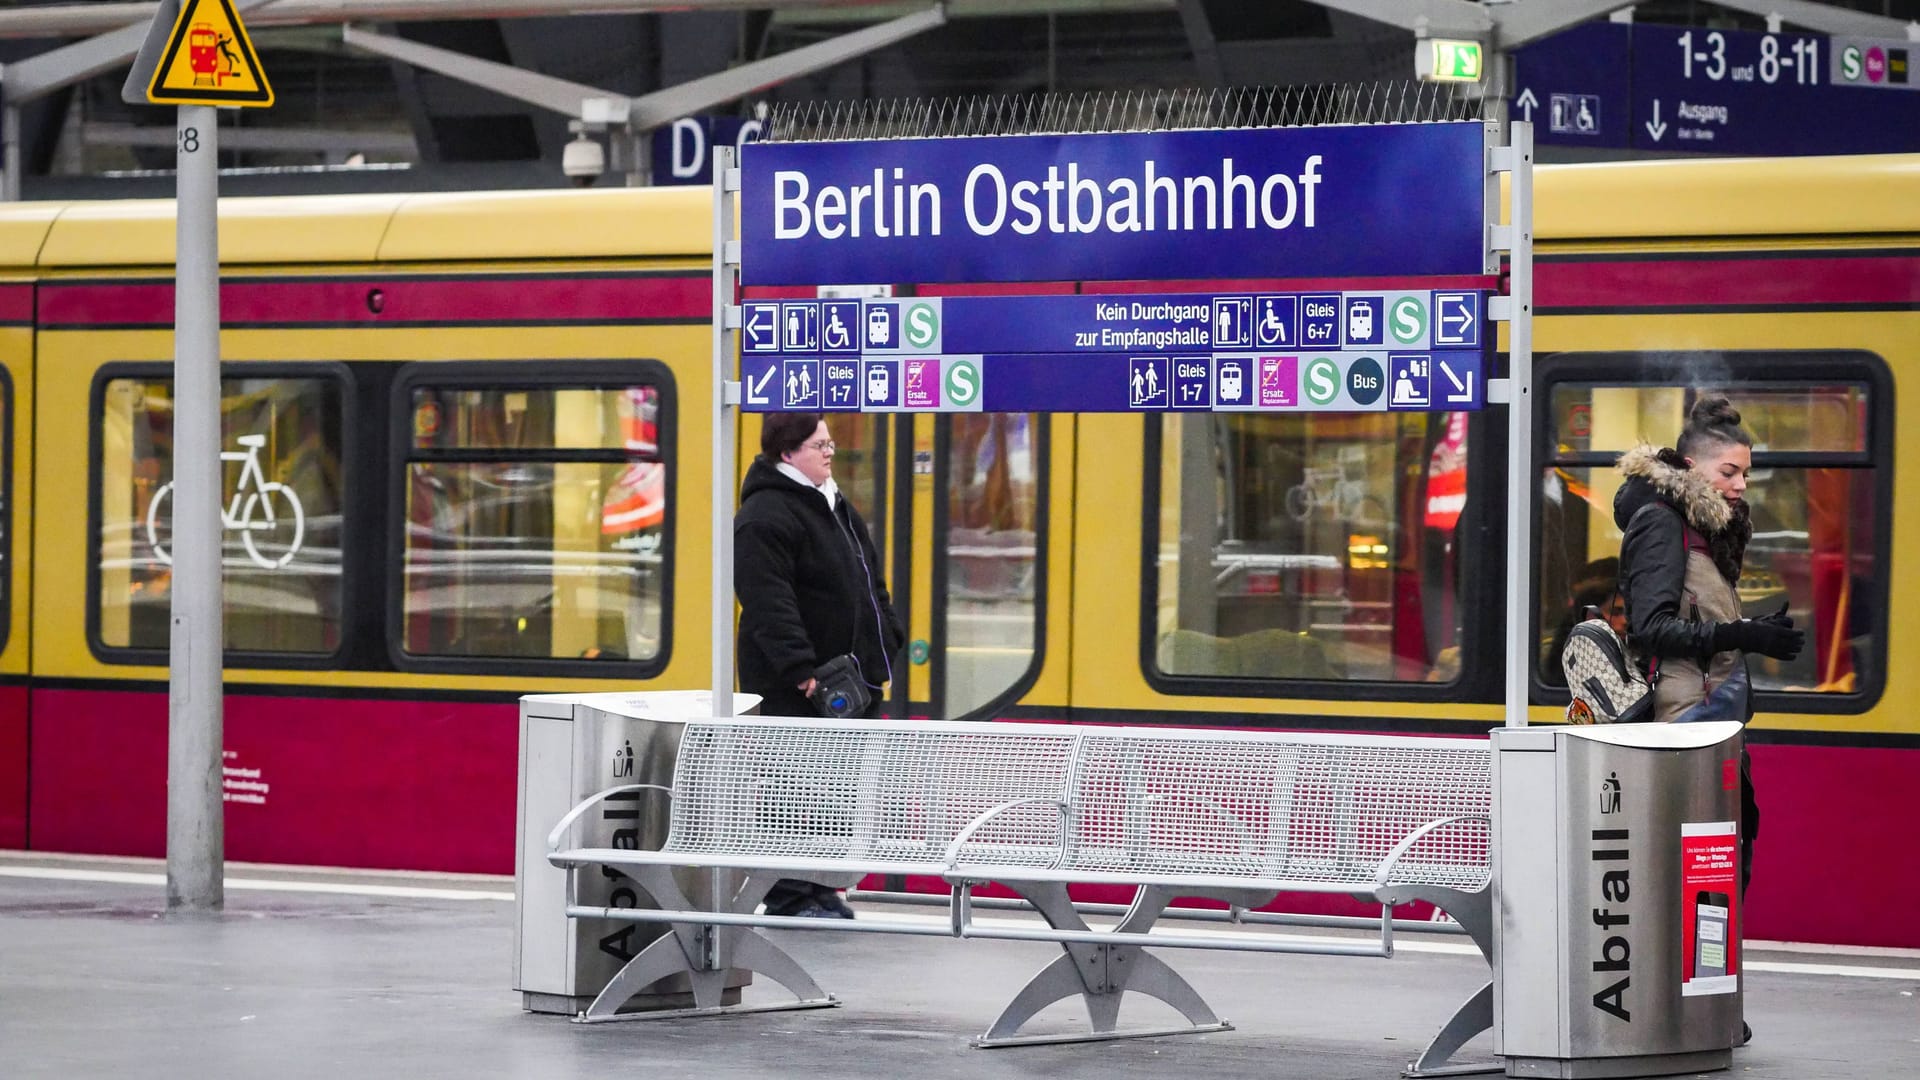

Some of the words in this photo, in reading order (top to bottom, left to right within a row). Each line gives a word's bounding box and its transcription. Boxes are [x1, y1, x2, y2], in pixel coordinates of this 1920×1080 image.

[1678, 31, 1726, 80] 1-3
[1731, 64, 1754, 81] und
[1759, 35, 1818, 85] 8-11
[1843, 47, 1860, 79] S
[1678, 100, 1728, 124] Ausgang
[672, 118, 705, 178] D
[774, 168, 942, 240] Berlin
[963, 155, 1322, 236] Ostbahnhof
[1096, 303, 1127, 321] Kein
[1131, 302, 1210, 324] Durchgang
[1305, 303, 1335, 317] Gleis
[1395, 301, 1420, 339] S
[910, 307, 933, 344] S
[1307, 323, 1333, 339] 6+7
[1075, 332, 1099, 347] zur
[1102, 327, 1209, 350] Empfangshalle
[828, 365, 854, 379] Gleis
[1178, 363, 1206, 378] Gleis
[1310, 362, 1334, 400] S
[1353, 373, 1378, 389] Bus
[830, 385, 851, 402] 1-7
[907, 390, 927, 399] Ersatz
[951, 365, 974, 402] S
[1181, 383, 1203, 401] 1-7
[1262, 388, 1285, 398] Ersatz
[1592, 829, 1631, 1023] Abfall
